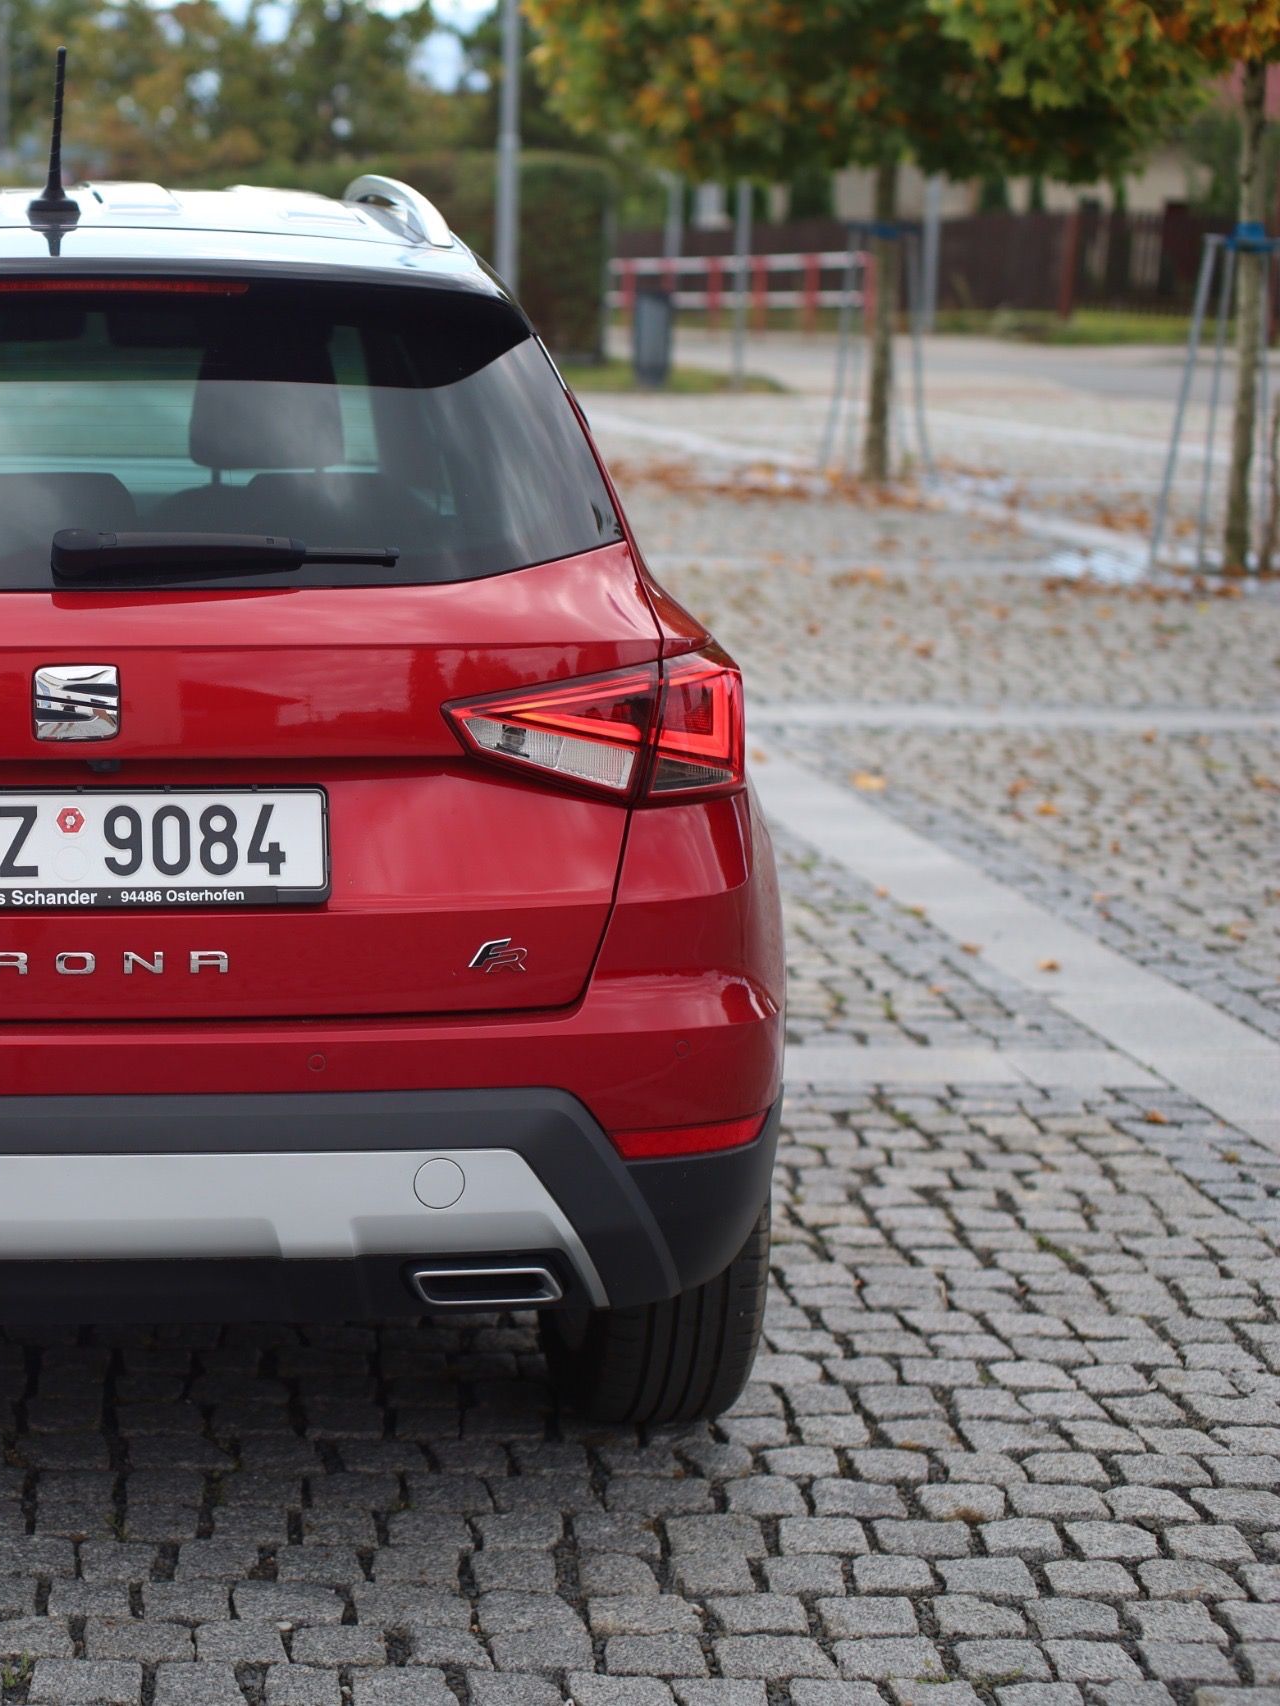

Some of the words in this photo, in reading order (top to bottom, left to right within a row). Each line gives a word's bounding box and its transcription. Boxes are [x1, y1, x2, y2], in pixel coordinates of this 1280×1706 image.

[103, 804, 286, 876] 9084
[11, 889, 97, 905] Schander
[120, 890, 162, 903] 94486
[166, 889, 244, 902] Osterhofen
